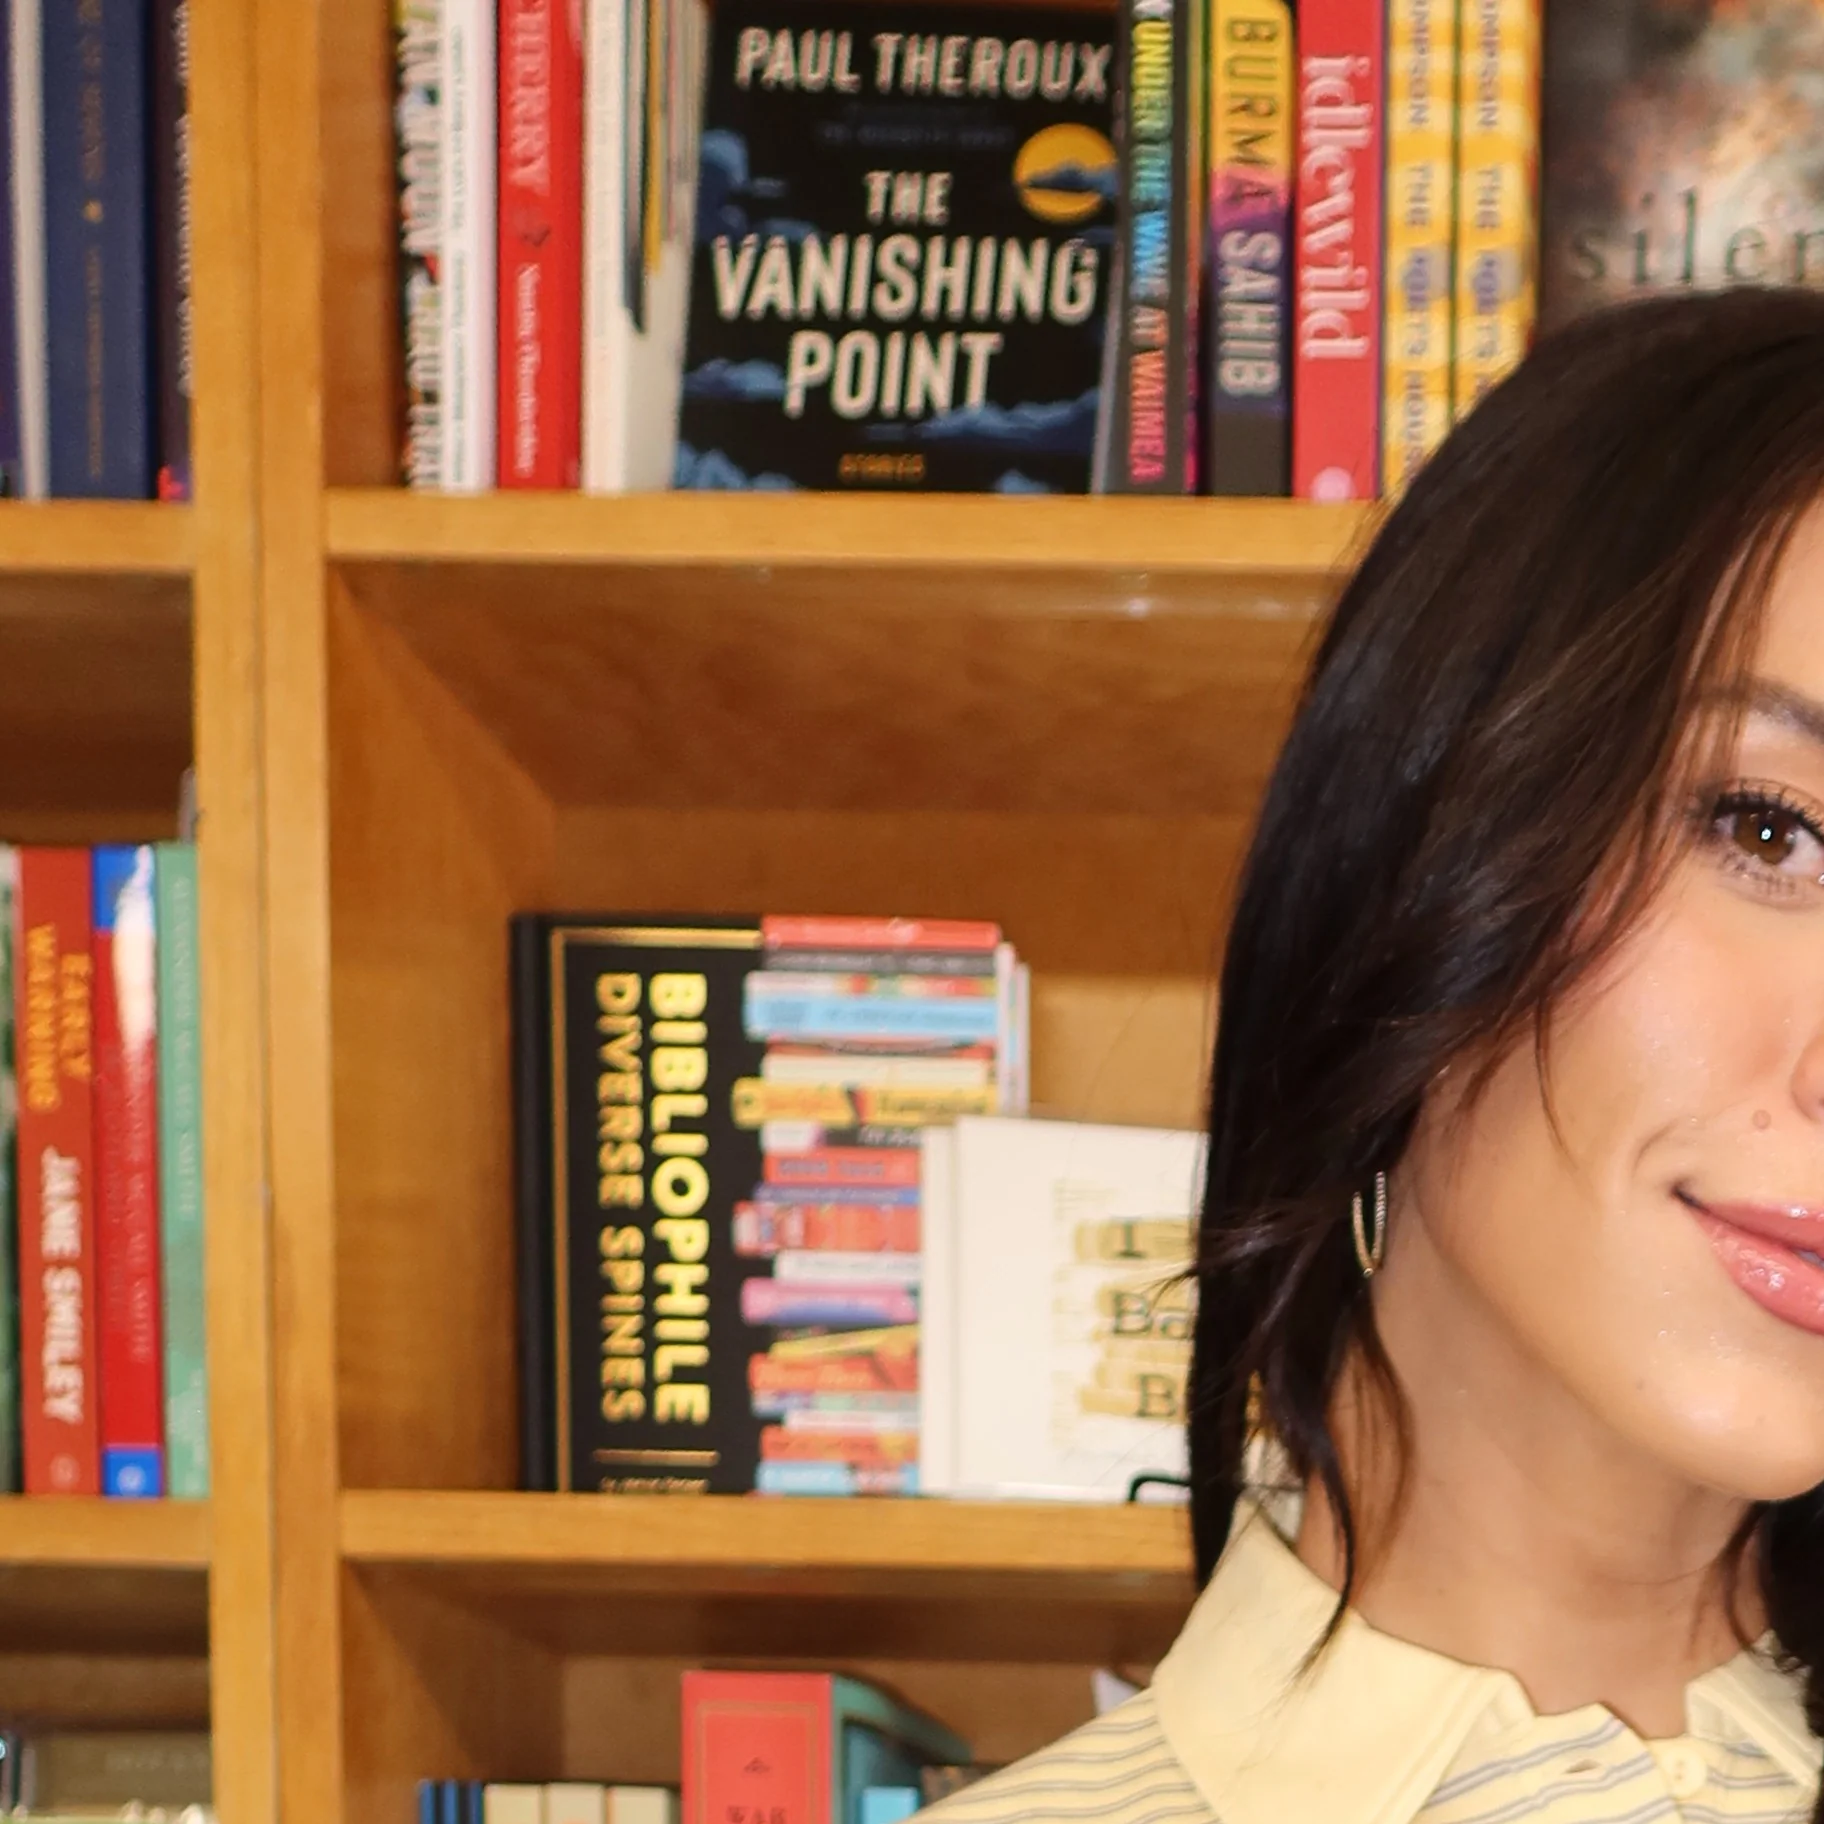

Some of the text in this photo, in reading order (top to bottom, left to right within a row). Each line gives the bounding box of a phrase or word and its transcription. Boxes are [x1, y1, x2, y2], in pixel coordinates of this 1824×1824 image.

[735, 27, 1112, 104] PAUL THEROUX
[1408, 0, 1430, 125] MPSON
[1478, 0, 1501, 128] MPSON
[864, 170, 952, 225] THE
[1129, 21, 1173, 484] UNDER THE WAVE AT WAIMEA
[1219, 19, 1280, 395] BURMA SAHIB
[1299, 55, 1374, 361] idlewild
[1405, 164, 1431, 227] THE
[1476, 166, 1501, 230] THE
[712, 233, 1098, 323] VANISHING
[783, 329, 1004, 419] POINT
[1402, 371, 1429, 470] HOUS
[26, 926, 60, 1113] WARNING
[60, 953, 92, 1081] EARLY
[597, 973, 645, 1421] DIVERSE SPINES
[649, 972, 709, 1423] BIBLIOPHILE
[43, 1148, 84, 1425] JANE SMILEY
[1111, 1290, 1192, 1342] Ba
